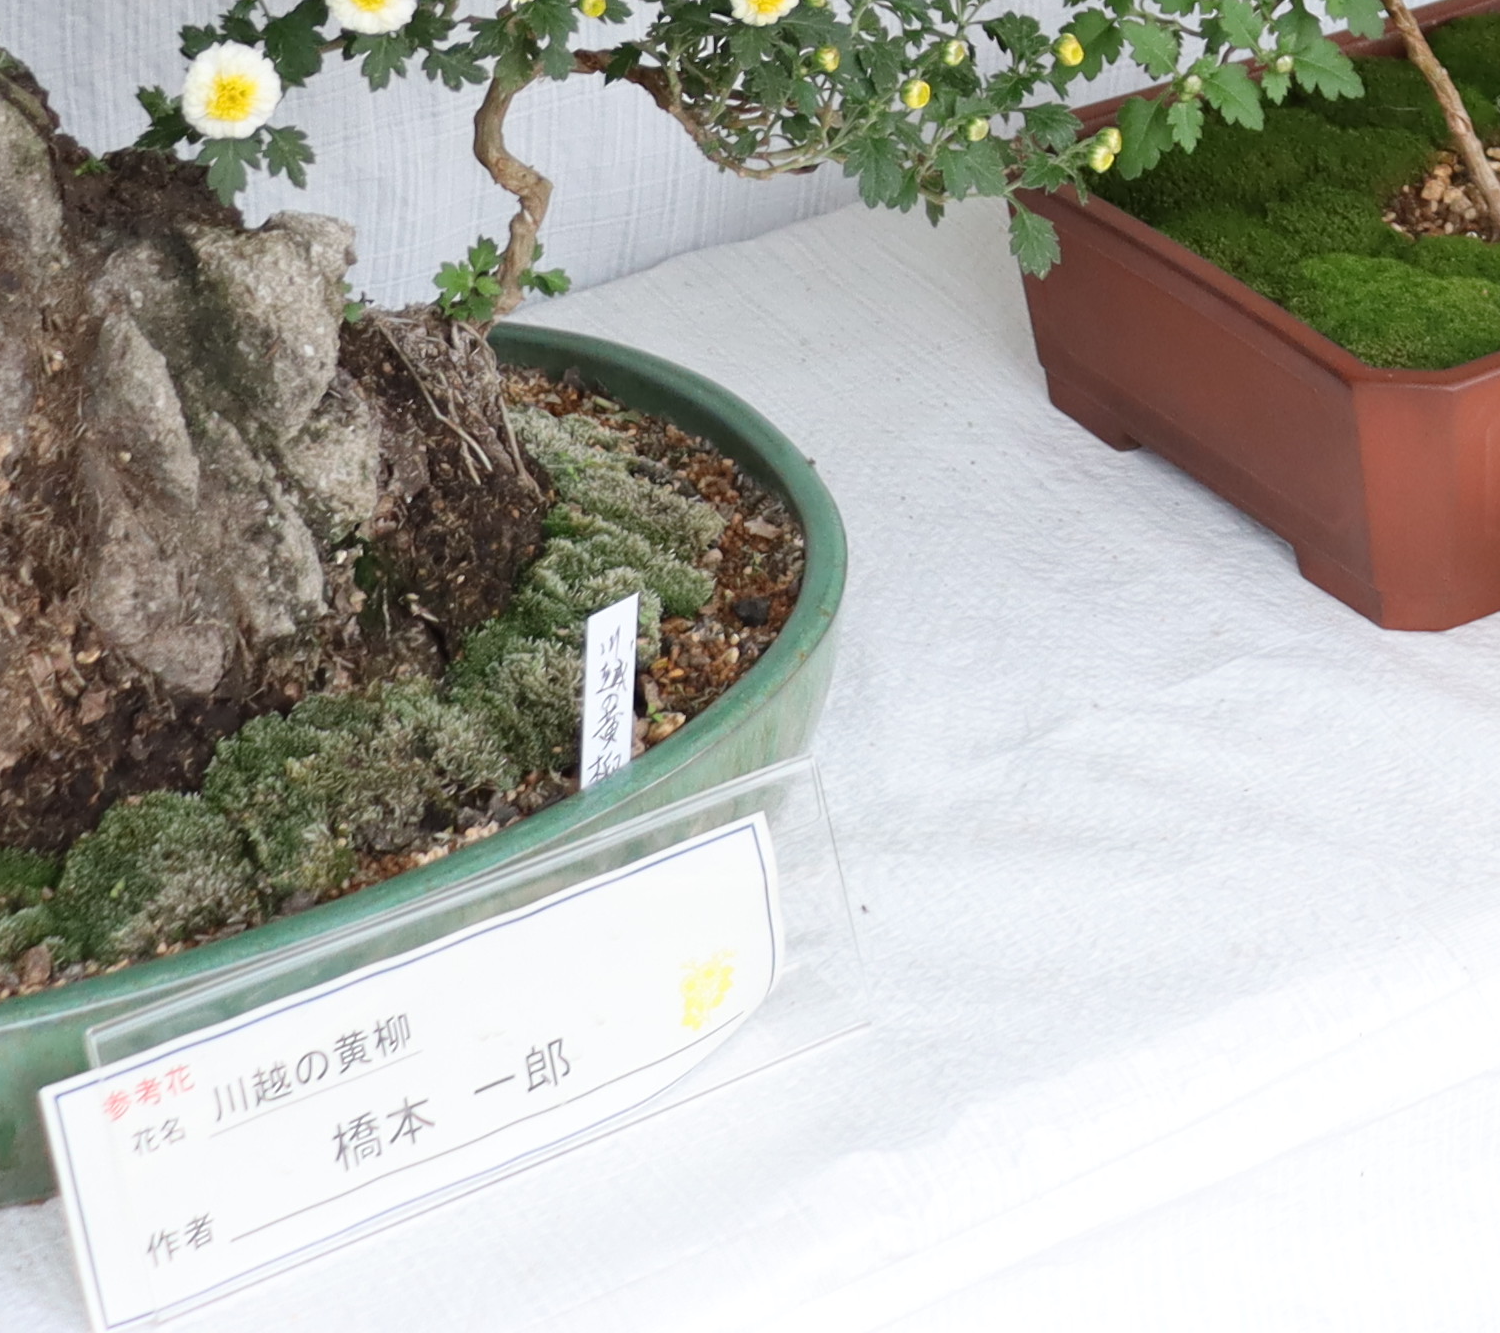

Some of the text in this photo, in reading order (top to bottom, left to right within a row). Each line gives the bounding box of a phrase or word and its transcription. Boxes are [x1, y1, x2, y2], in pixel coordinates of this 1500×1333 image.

[102, 1063, 197, 1123] 参考花
[130, 1012, 412, 1158] 花名 川越の黄柳
[331, 1037, 572, 1172] 橋本 一郎
[145, 1213, 216, 1269] 作者
